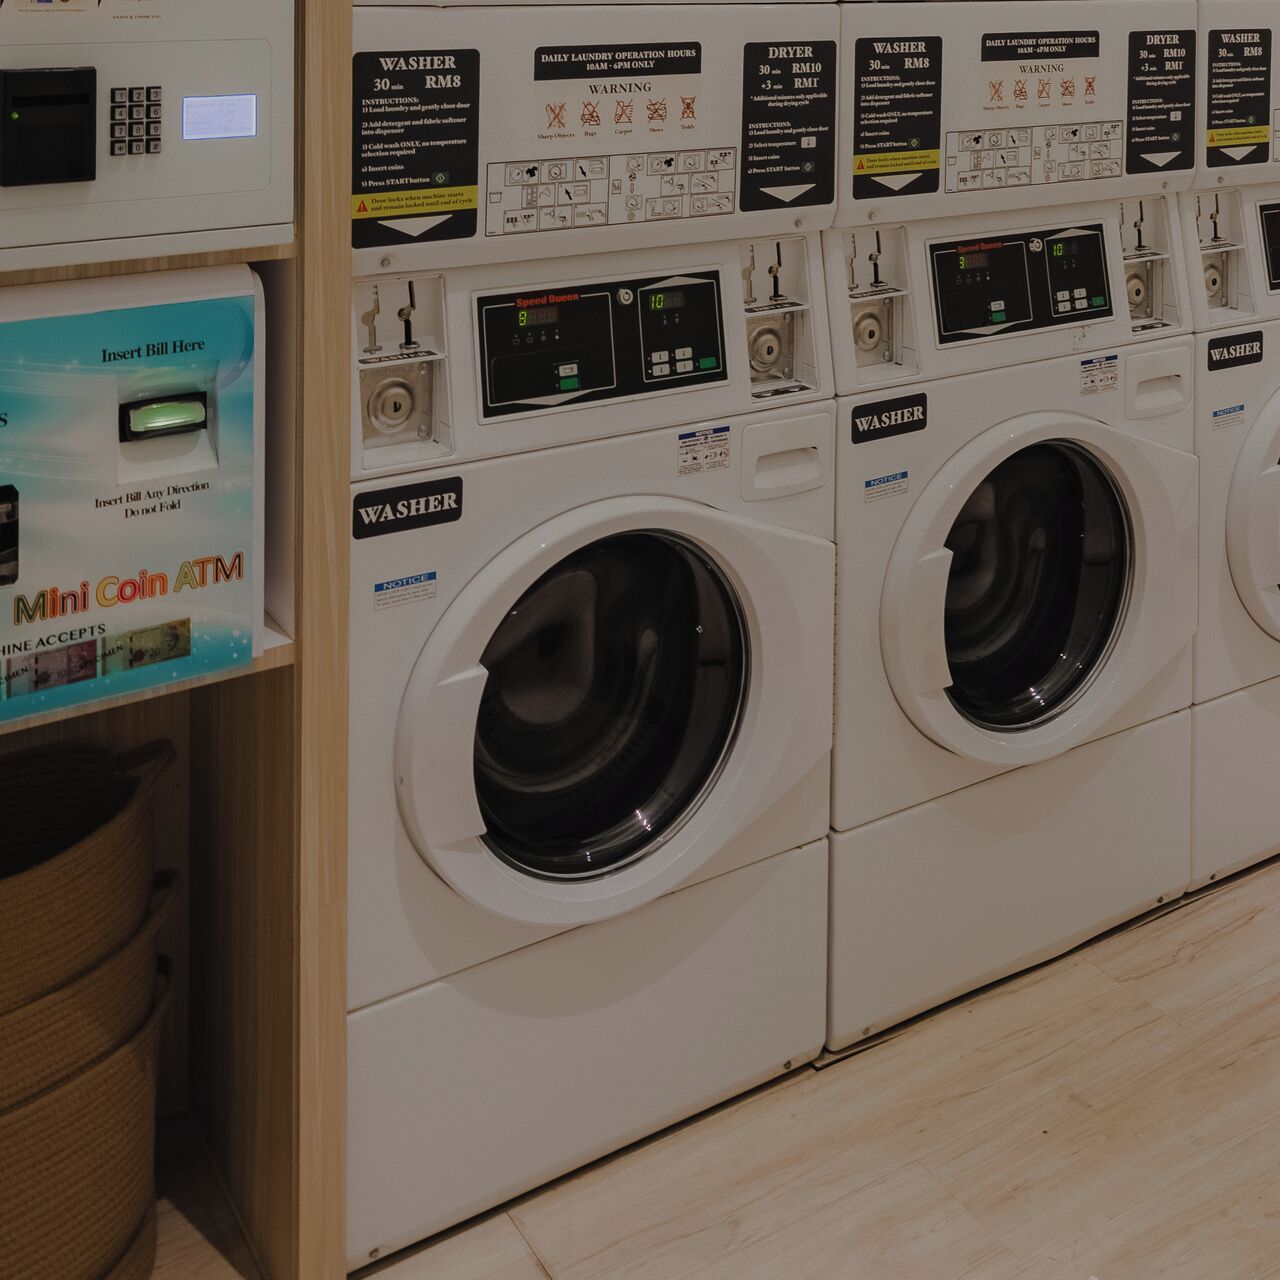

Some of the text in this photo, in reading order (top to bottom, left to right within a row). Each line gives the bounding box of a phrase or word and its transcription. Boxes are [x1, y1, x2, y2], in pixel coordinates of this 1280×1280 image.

[985, 36, 1096, 47] DAILY LAUNDRY OPERATION HOURS
[1146, 34, 1180, 45] DRYER
[1221, 33, 1260, 43] WASHER
[768, 46, 813, 59] DRYER
[872, 41, 926, 54] WASHER
[1139, 48, 1186, 59] 30 RM10
[1218, 46, 1263, 58] 30 RM8
[541, 49, 696, 63] DAILY LAUNDRY OPERATION HOURS
[379, 56, 456, 70] WASHER
[586, 60, 655, 71] 10AM 6PM ONLY
[759, 64, 770, 75] 30
[792, 62, 822, 74] RM10
[868, 57, 930, 71] 30 RM8
[1020, 64, 1065, 74] WARNING
[373, 78, 390, 91] 30
[425, 75, 461, 89] RM8
[589, 82, 652, 95] WARNING
[760, 80, 771, 90] +3
[362, 97, 420, 105] INSTRUCTIONS:
[385, 105, 409, 113] laundry
[422, 104, 440, 112] gently
[381, 120, 411, 128] detergent
[375, 128, 405, 136] dispenser
[537, 132, 575, 141] Sharp Objects
[584, 130, 597, 138] Bags
[614, 128, 633, 136] Carpet
[430, 139, 467, 147] temperature
[390, 149, 416, 157] required
[1053, 243, 1063, 256] 10
[516, 293, 580, 309] Speed Queen
[651, 295, 664, 310] 10
[101, 339, 205, 363] Insert Bill Here
[1210, 341, 1261, 362] WASHER
[855, 405, 923, 432] WASHER
[870, 473, 905, 487] NOTICE
[95, 482, 210, 508] Insert Bill Any Direction
[125, 499, 181, 518] Do not Fold
[359, 492, 457, 524] WASHER
[14, 551, 244, 625] Mini Coin ATM
[383, 574, 429, 590] NOTICE
[35, 623, 106, 649] ACCEPTS
